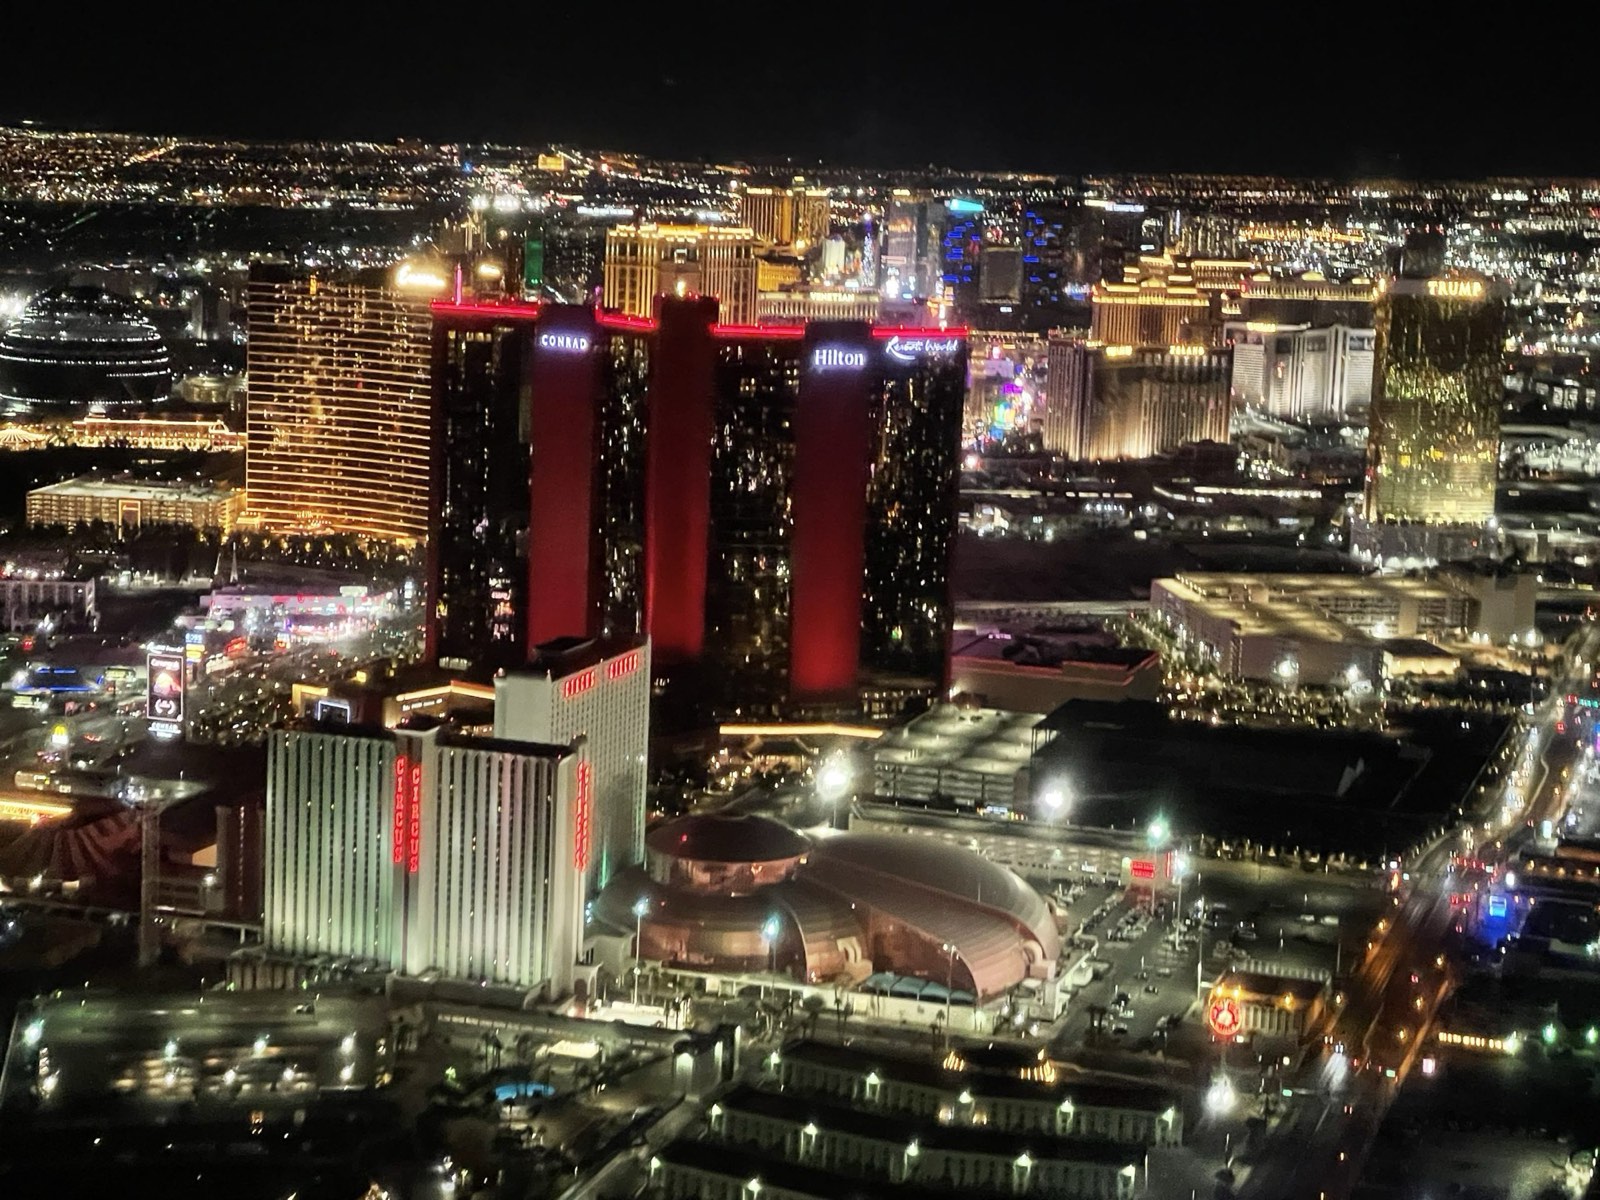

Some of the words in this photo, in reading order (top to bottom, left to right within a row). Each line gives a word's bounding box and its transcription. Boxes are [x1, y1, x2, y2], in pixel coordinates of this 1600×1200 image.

[1427, 280, 1483, 297] TRUMP
[541, 334, 588, 350] CONRAD
[815, 349, 864, 366] Hilton
[394, 758, 405, 863] CIRCUS
[410, 767, 420, 872] CIRCUS
